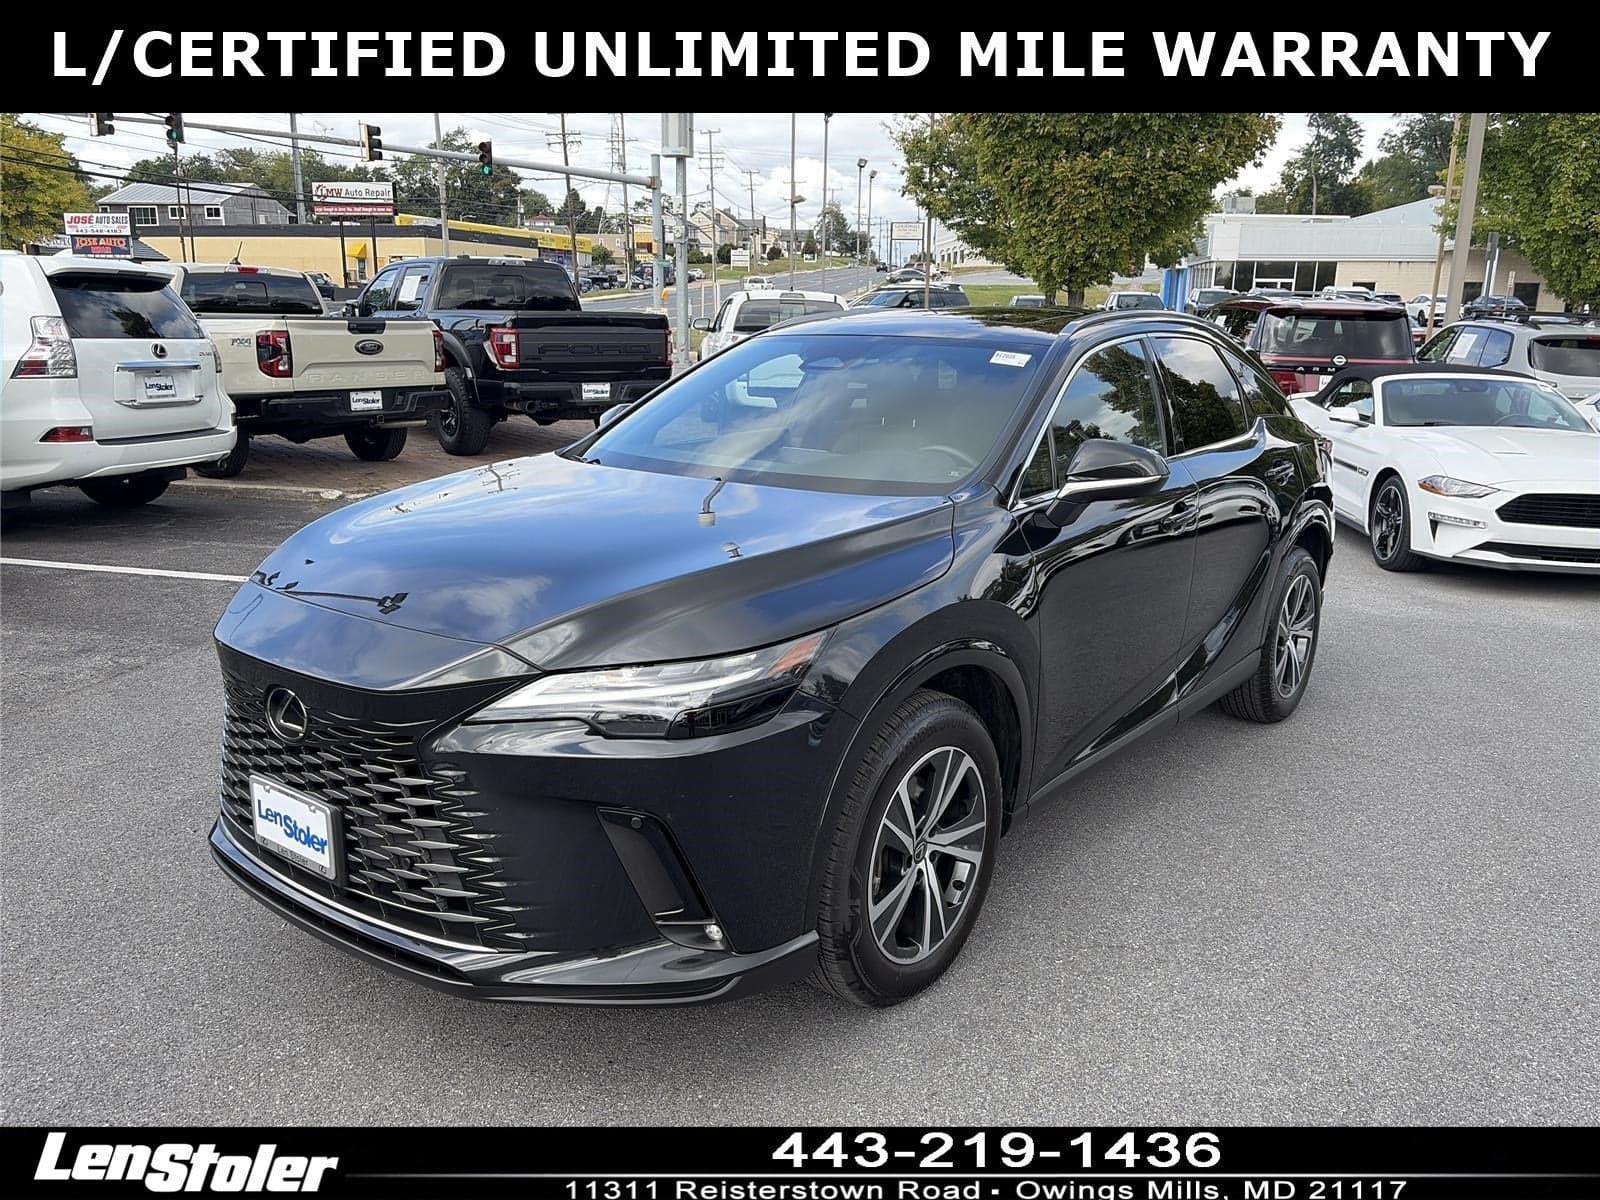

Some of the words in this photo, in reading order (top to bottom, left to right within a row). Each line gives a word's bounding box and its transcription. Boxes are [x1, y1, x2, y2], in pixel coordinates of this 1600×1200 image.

[345, 188, 363, 197] Auto
[364, 188, 391, 198] Repair
[67, 214, 94, 224] JOSÉ
[95, 215, 110, 225] AUTO
[111, 215, 128, 225] SALES
[99, 237, 126, 247] AUTO
[257, 800, 327, 854] LenStoler
